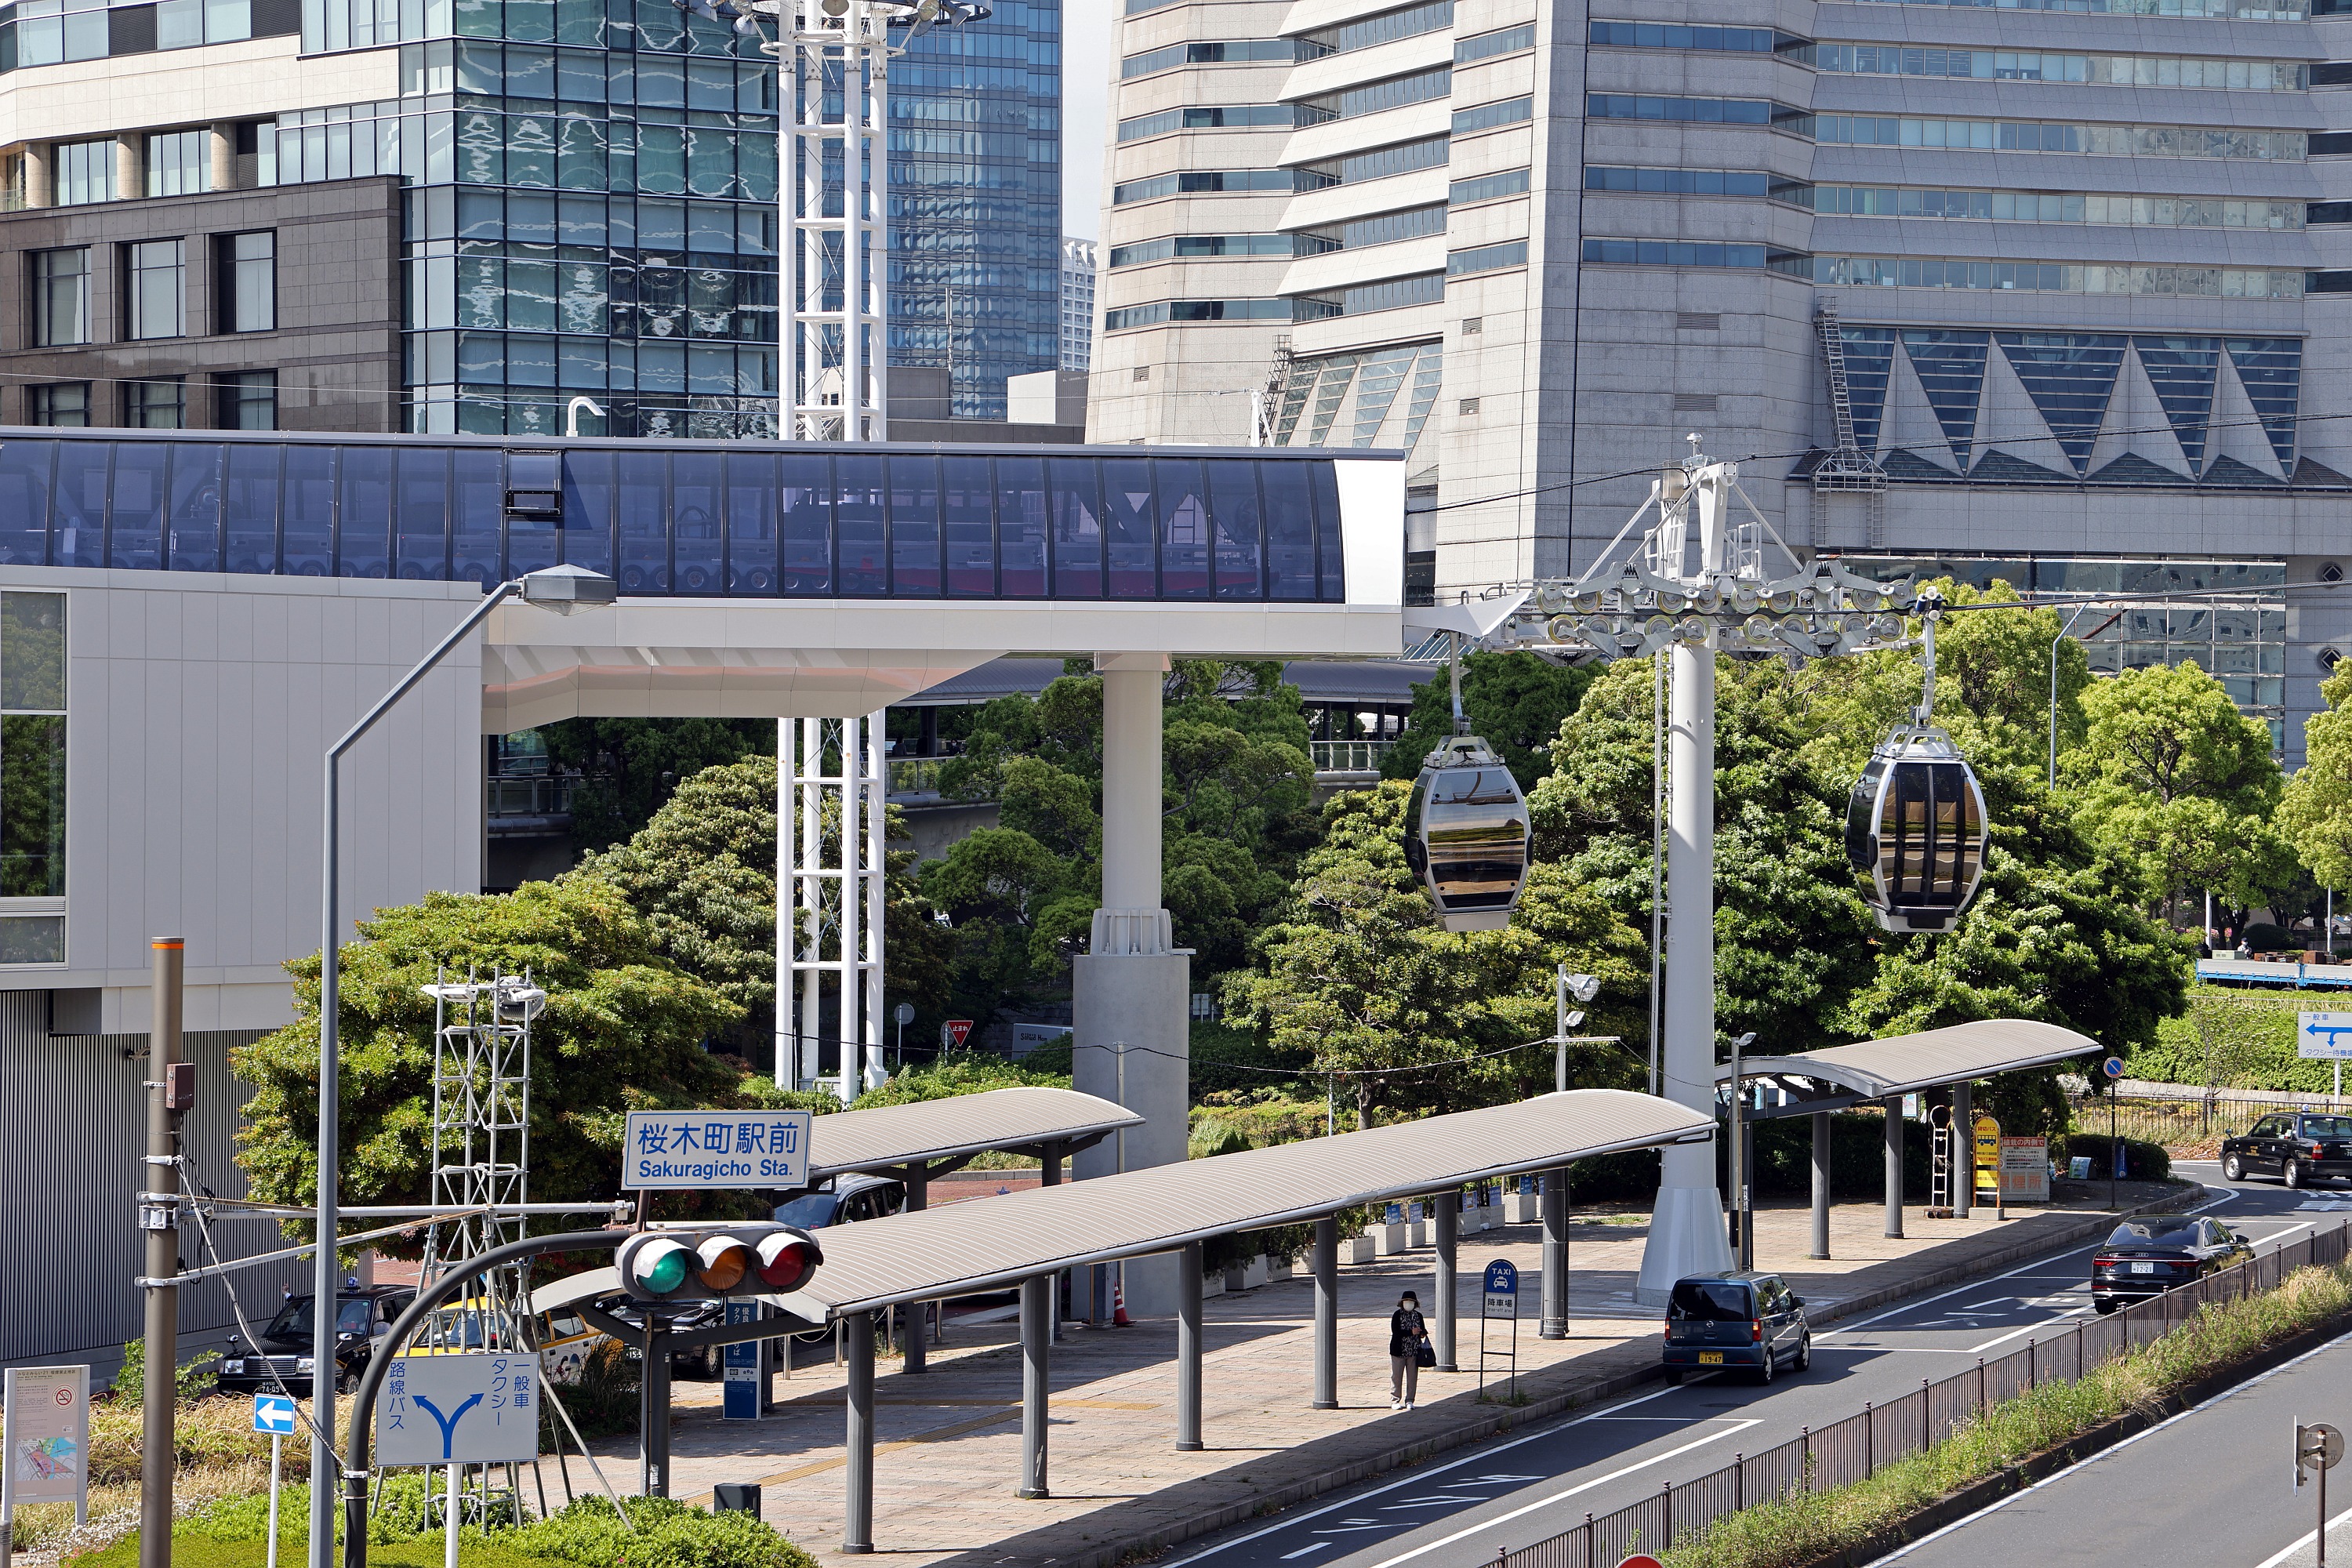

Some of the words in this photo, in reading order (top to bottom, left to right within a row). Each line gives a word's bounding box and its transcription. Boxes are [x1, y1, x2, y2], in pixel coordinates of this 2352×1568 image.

[637, 1122, 799, 1155] 桜木町駅前
[639, 1160, 752, 1181] Sakuragicho
[760, 1159, 793, 1176] Sta.
[742, 1307, 750, 1323] 優良
[1487, 1298, 1512, 1307] 降車場
[389, 1362, 405, 1430] 路線バス
[492, 1359, 507, 1426] タクシー
[514, 1363, 531, 1409] 一般車
